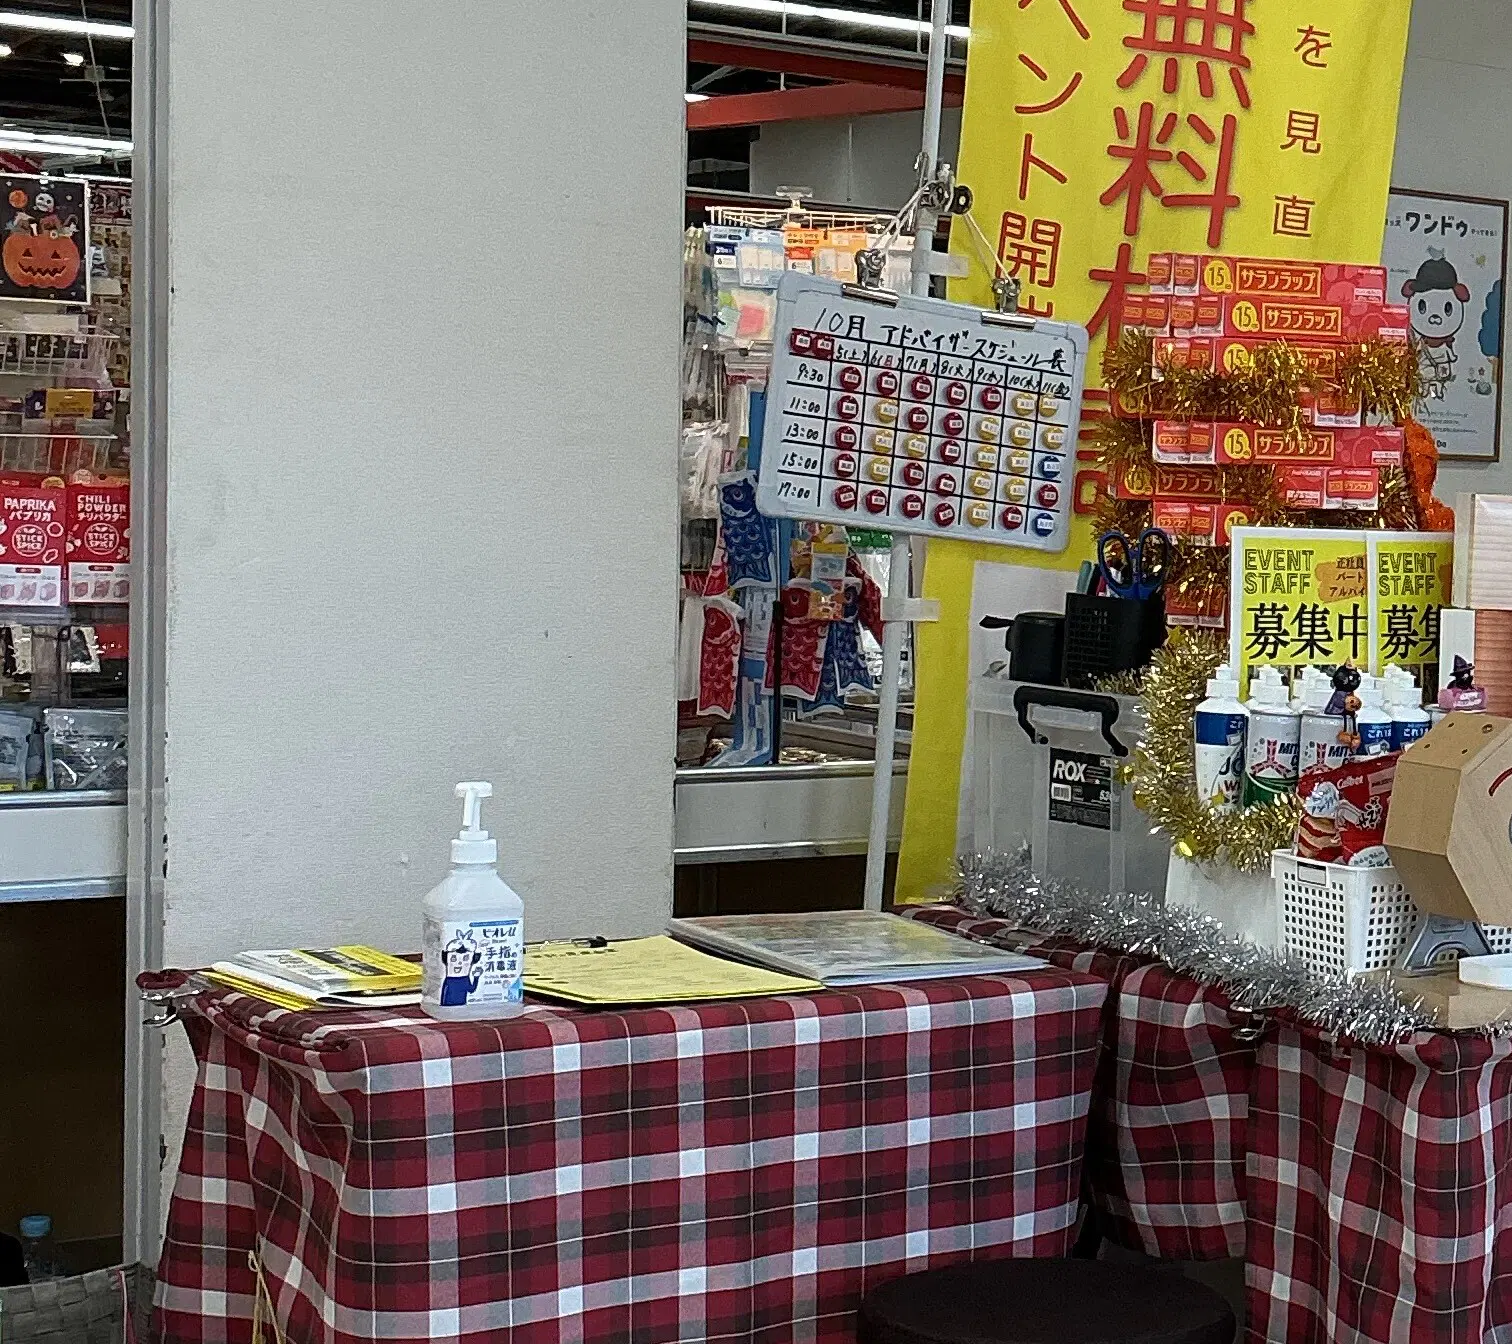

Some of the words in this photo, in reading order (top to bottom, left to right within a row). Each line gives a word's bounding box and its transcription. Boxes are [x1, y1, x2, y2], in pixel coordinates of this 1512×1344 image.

[1405, 211, 1468, 237] ワンドゥ
[1240, 270, 1317, 292] サランラップ
[814, 308, 865, 339] 10月
[1266, 309, 1338, 332] サランラップ
[797, 363, 824, 383] 9:30
[790, 396, 820, 414] 11:00
[786, 423, 819, 441] 13:00
[781, 452, 818, 470] 15:00
[77, 494, 110, 504] CHILI
[777, 483, 811, 500] 17:00
[4, 497, 57, 511] PAPRIKA
[9, 511, 52, 522] パプリカ
[1244, 548, 1314, 571] EVENT
[1379, 552, 1437, 574] EVENT
[1243, 573, 1311, 595] STAFF
[1379, 575, 1435, 597] STAFF
[1245, 602, 1367, 660] 募集中
[1053, 759, 1088, 783] ROX
